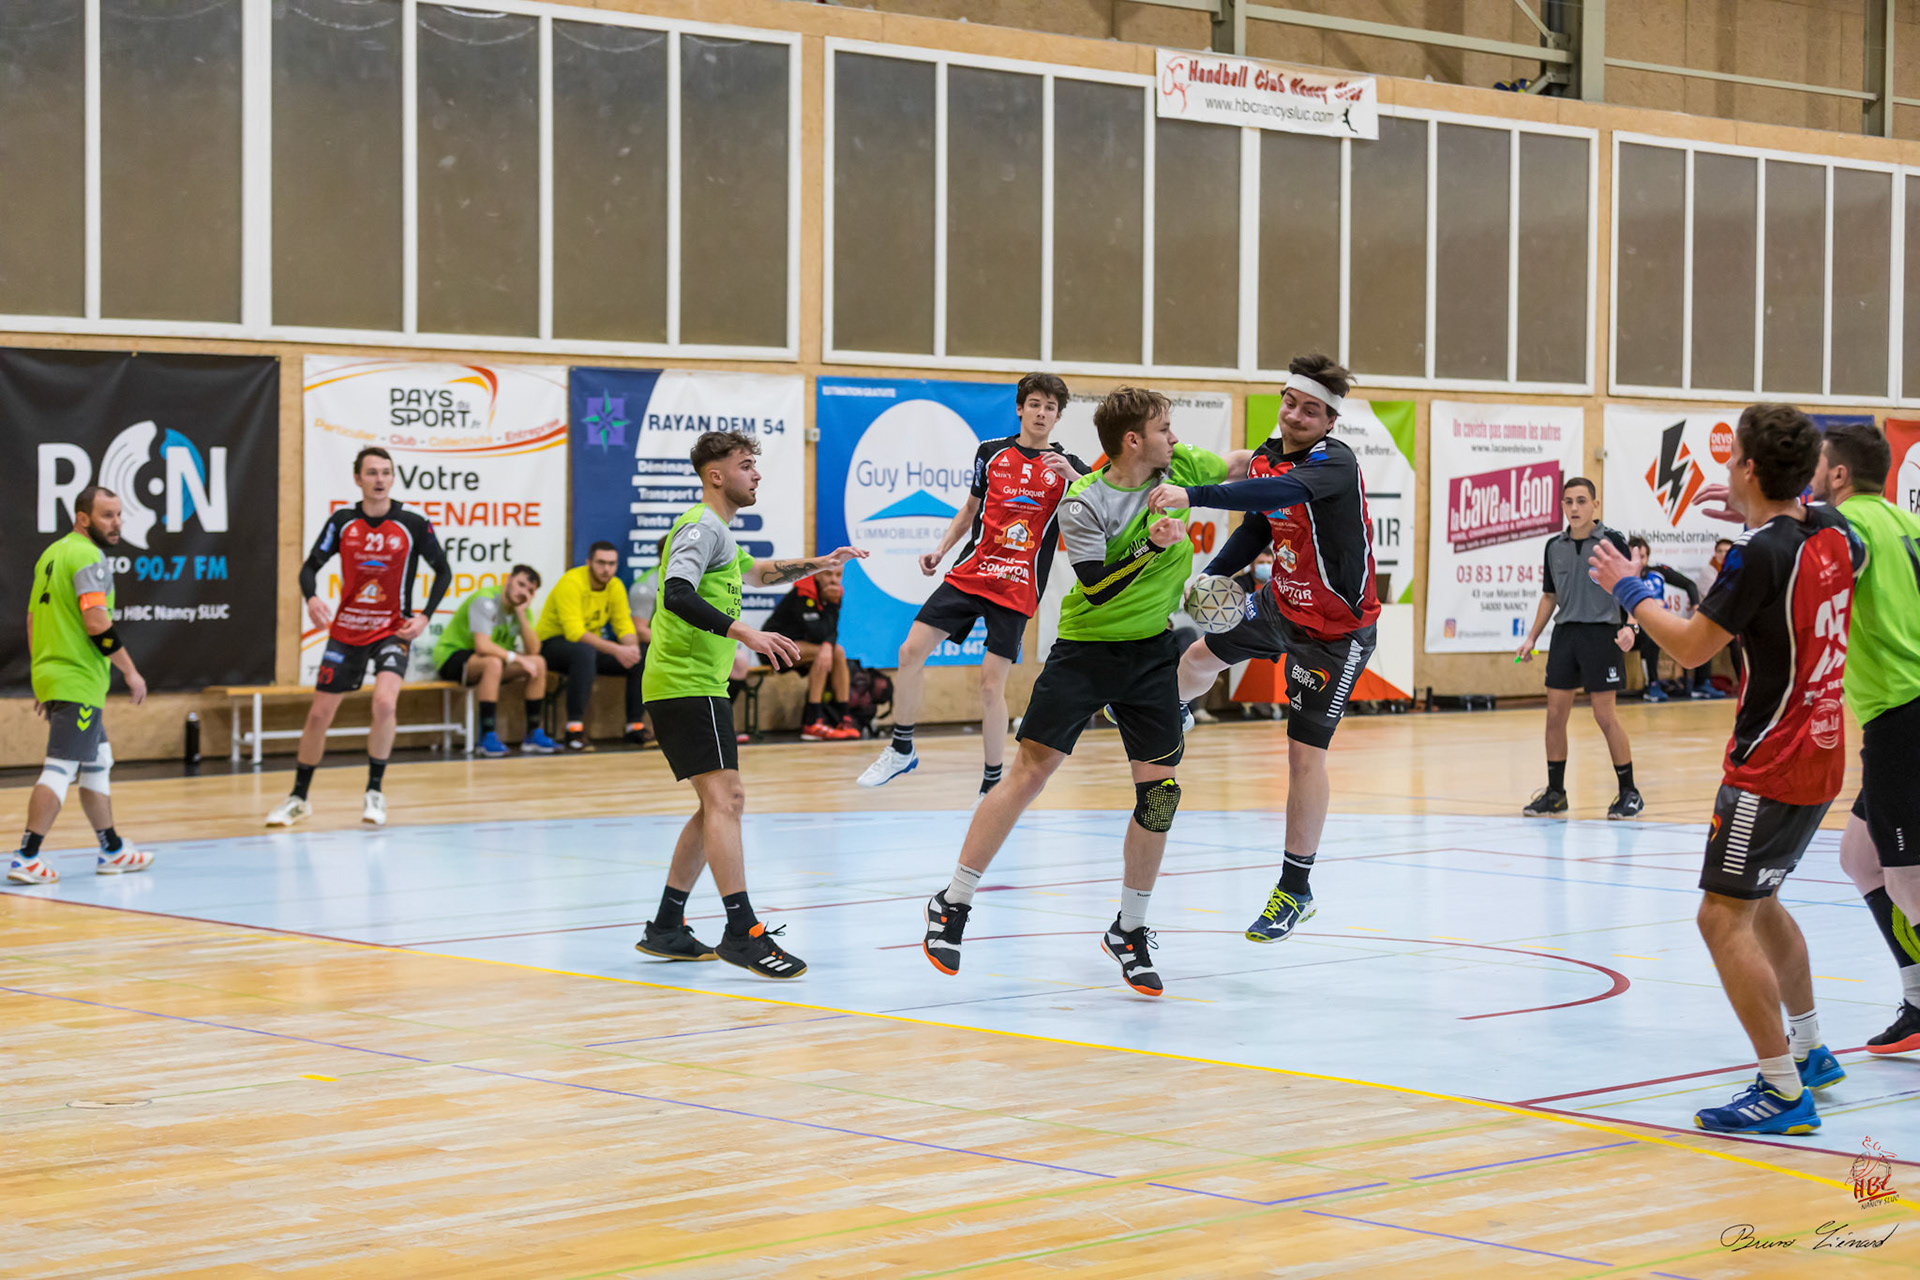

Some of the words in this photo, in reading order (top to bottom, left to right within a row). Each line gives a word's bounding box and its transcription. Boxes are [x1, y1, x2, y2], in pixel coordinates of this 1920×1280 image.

[1189, 60, 1248, 88] Handball
[1254, 69, 1285, 93] Club
[1205, 97, 1335, 122] www.hbcnancysluc.com
[390, 388, 453, 408] PAYS
[390, 409, 470, 428] SPORT
[648, 414, 711, 432] RAYAN
[717, 416, 755, 434] DEM
[763, 419, 785, 435] 54
[314, 418, 376, 440] Particulier
[390, 434, 416, 446] Club
[505, 419, 560, 442] Entreprise
[1711, 432, 1733, 444] DEVIS
[398, 465, 480, 491] Votre
[856, 460, 899, 493] Guy
[907, 461, 974, 493] Hoque
[1020, 463, 1033, 484] 5
[638, 487, 693, 502] Transport
[1003, 486, 1018, 497] Guy
[1018, 487, 1045, 498] Hoquet
[1460, 478, 1500, 531] Cave
[1510, 467, 1553, 521] Léon
[443, 537, 512, 562] ffort
[135, 555, 187, 581] 90.7
[193, 555, 228, 581] FM
[1456, 565, 1472, 583] 03
[1475, 565, 1492, 583] 83
[1498, 565, 1513, 583] 17
[1517, 565, 1533, 583] 84
[741, 595, 775, 608] ubles
[1504, 602, 1528, 611] NANCY
[124, 605, 152, 621] HBC
[154, 605, 197, 623] Nancy
[197, 603, 230, 619] SLUC
